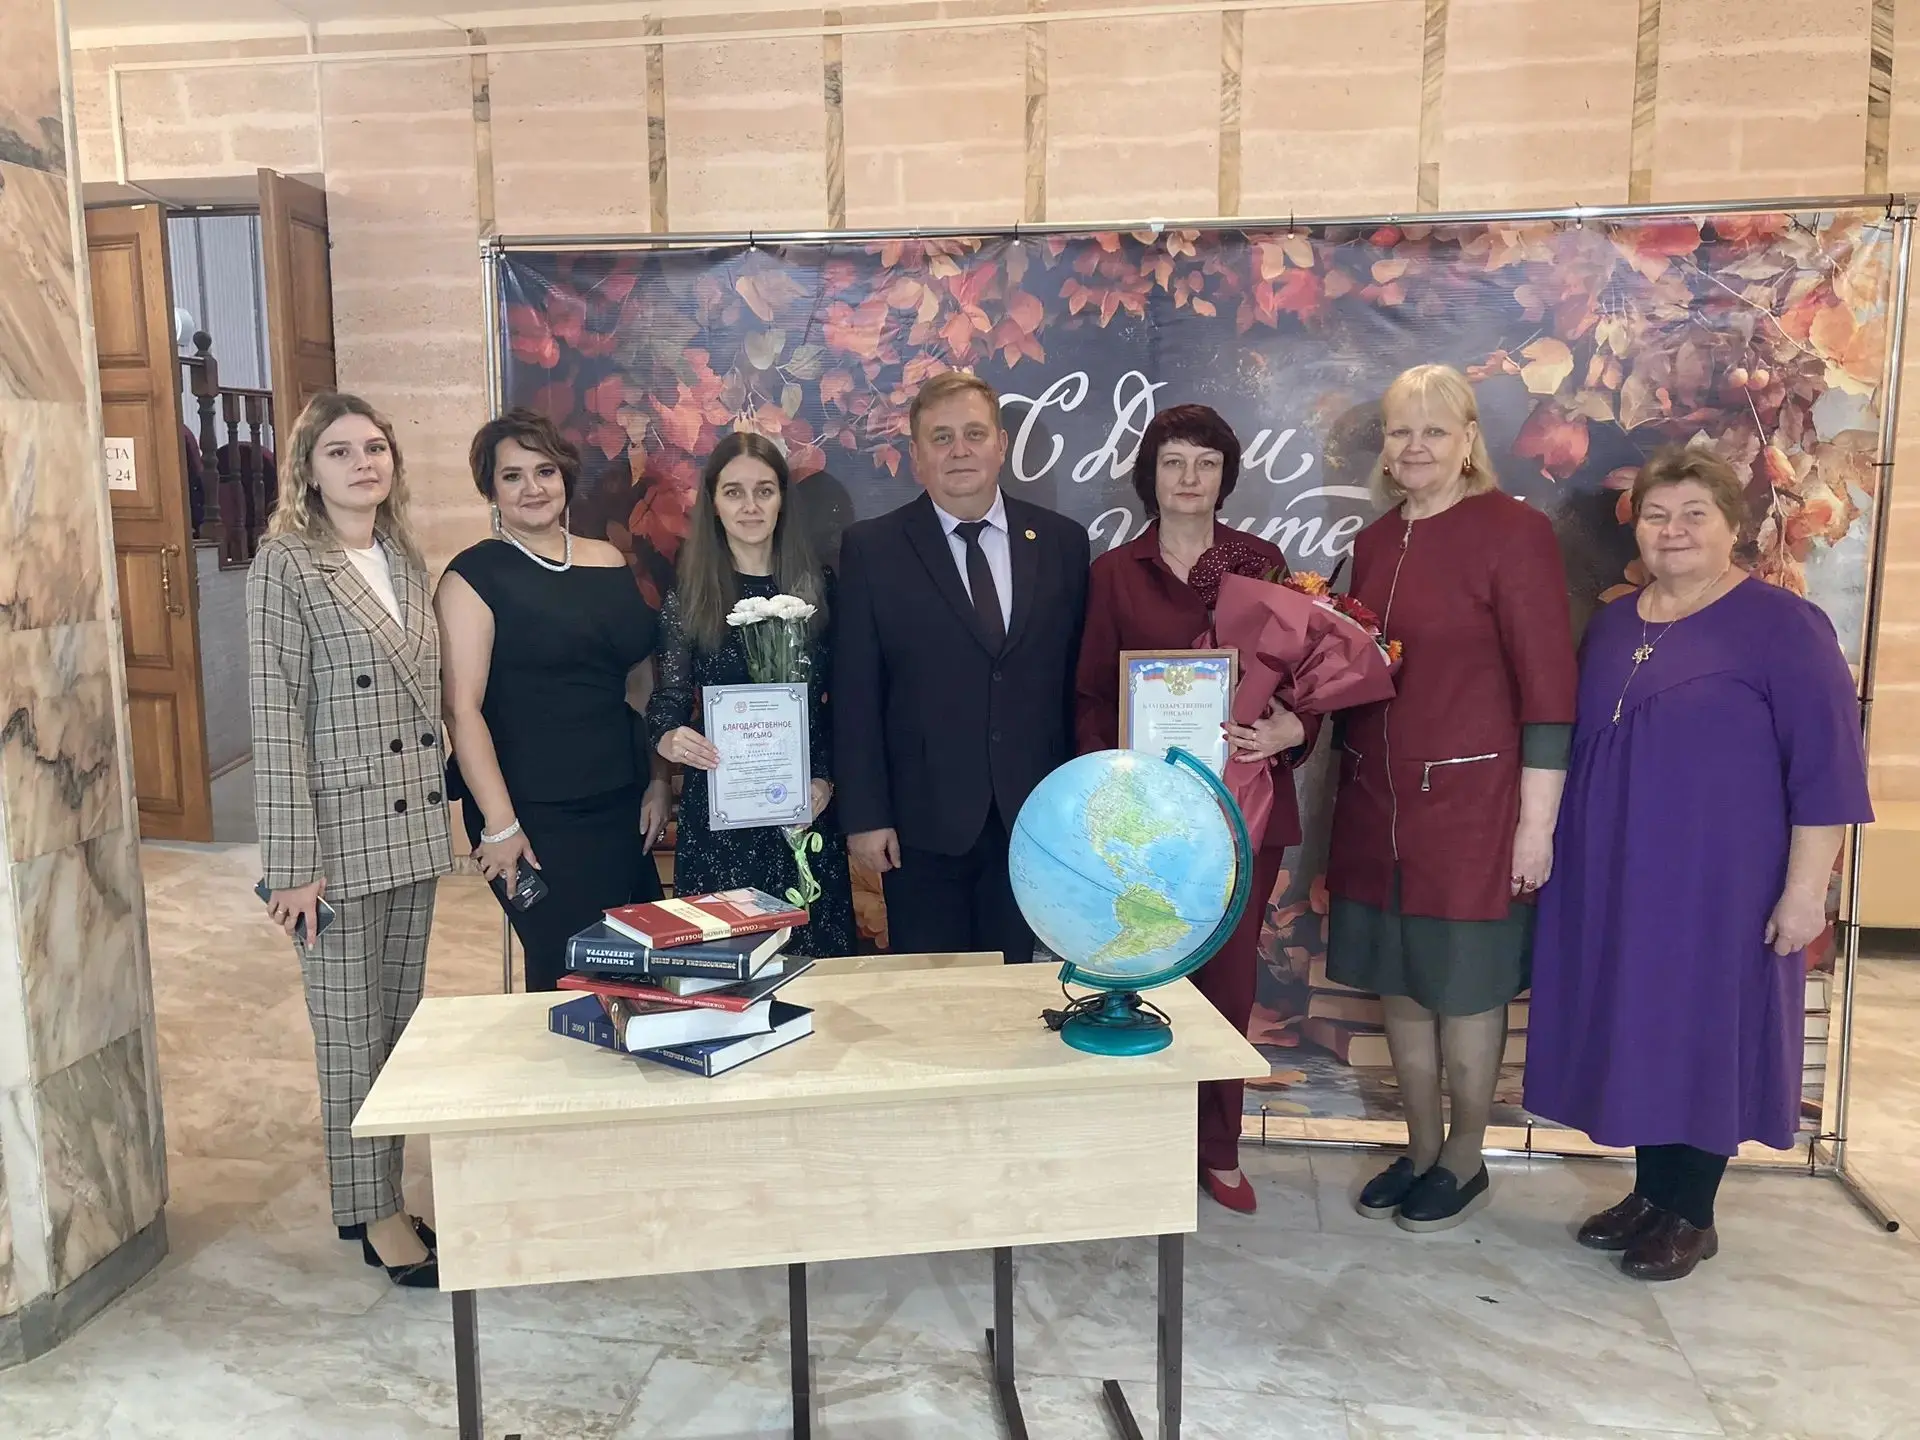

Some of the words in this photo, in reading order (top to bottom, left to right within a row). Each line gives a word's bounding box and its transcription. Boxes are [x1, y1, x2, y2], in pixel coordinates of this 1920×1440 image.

[997, 370, 1089, 482] С
[106, 447, 129, 460] СТА
[115, 468, 131, 481] 24
[722, 720, 792, 731] БЛАГОДАРСТВЕННОЕ
[743, 731, 773, 739] ПИСЬМО
[586, 949, 635, 958] ЛИТЕРАТУРА
[585, 956, 634, 966] ВСЕМИРНАЯ
